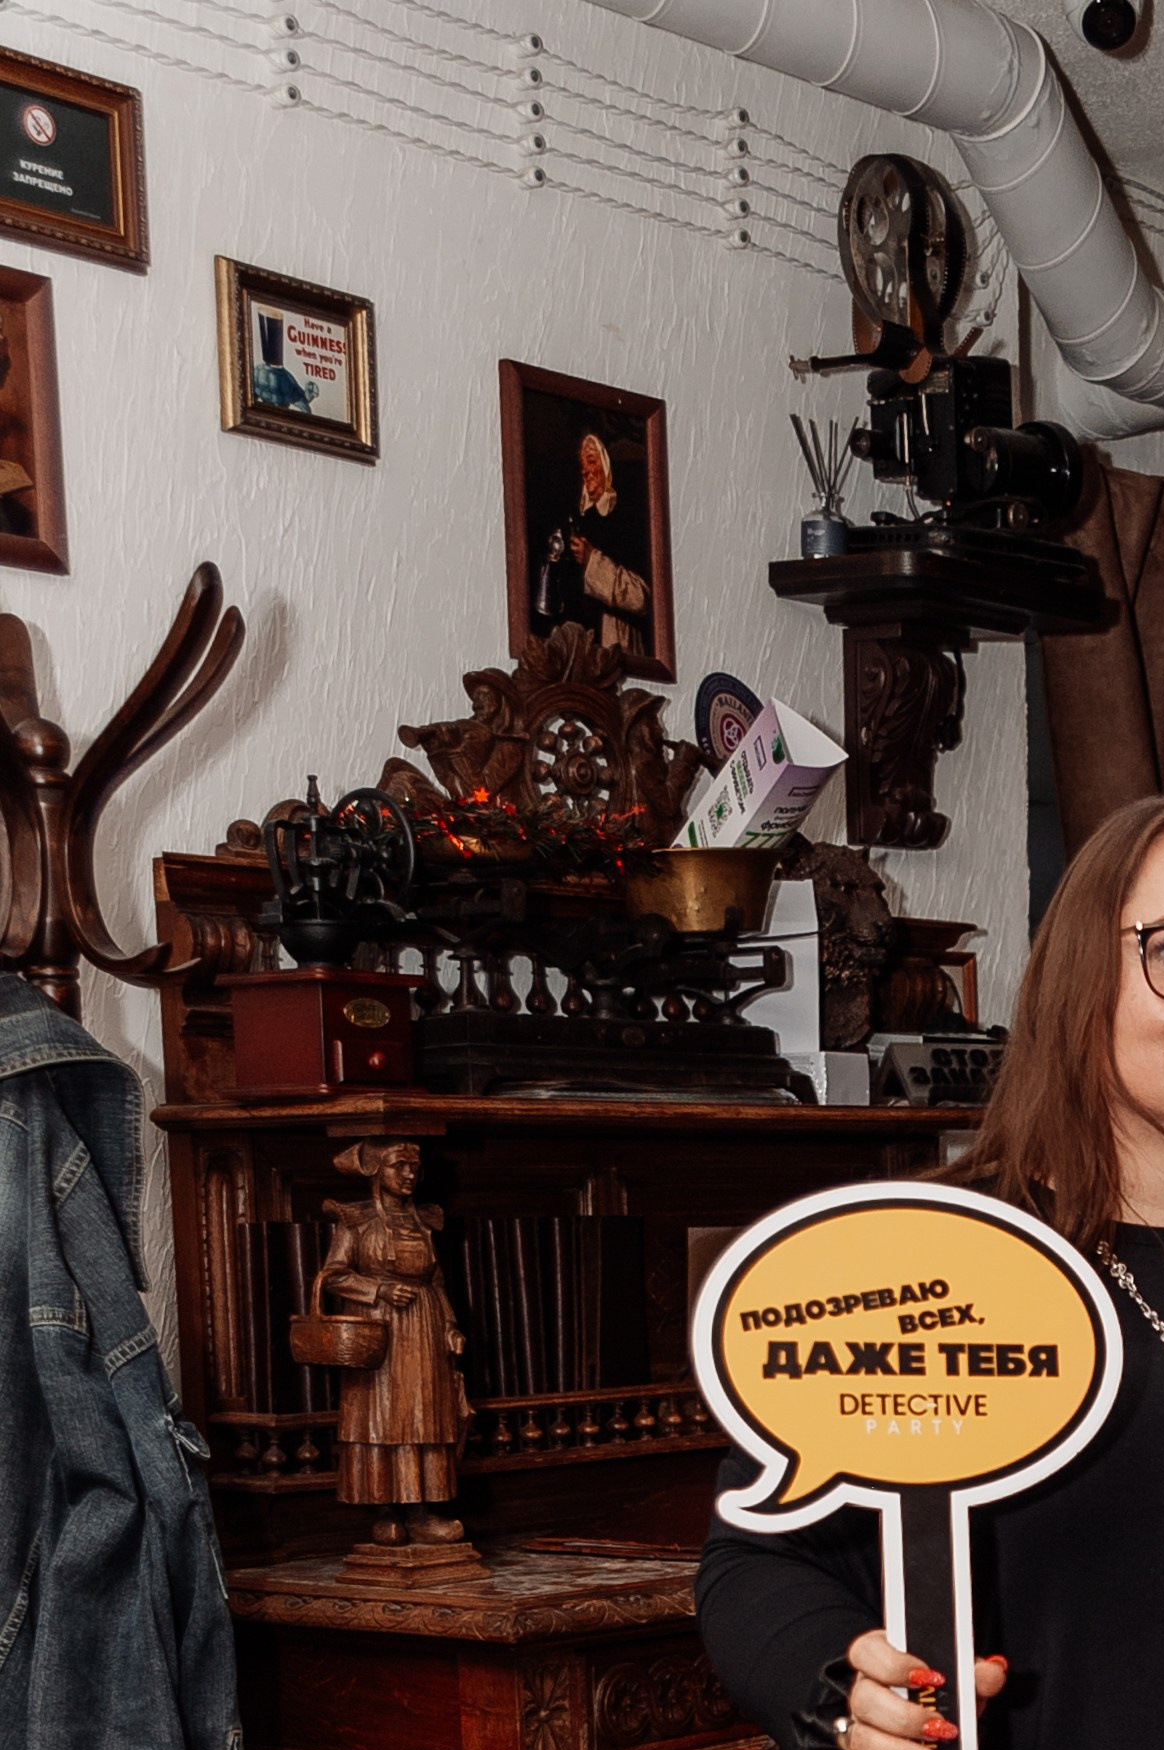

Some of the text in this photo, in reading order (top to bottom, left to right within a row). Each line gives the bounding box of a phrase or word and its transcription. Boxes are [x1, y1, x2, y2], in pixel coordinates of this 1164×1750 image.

[20, 159, 64, 180] КУРЕНИЕ
[12, 171, 74, 197] ЗАПРЕЩЕНО
[304, 317, 326, 332] Have
[295, 347, 317, 360] when
[303, 362, 336, 381] TIRED
[740, 1279, 950, 1332] ПОДОЗРЕВАЮ
[898, 1304, 986, 1335] ВСЕХ,
[762, 1341, 1060, 1379] ДАЖЕ ТЕБЯ
[839, 1393, 988, 1416] DETECTIVE
[866, 1419, 964, 1435] PARTY
